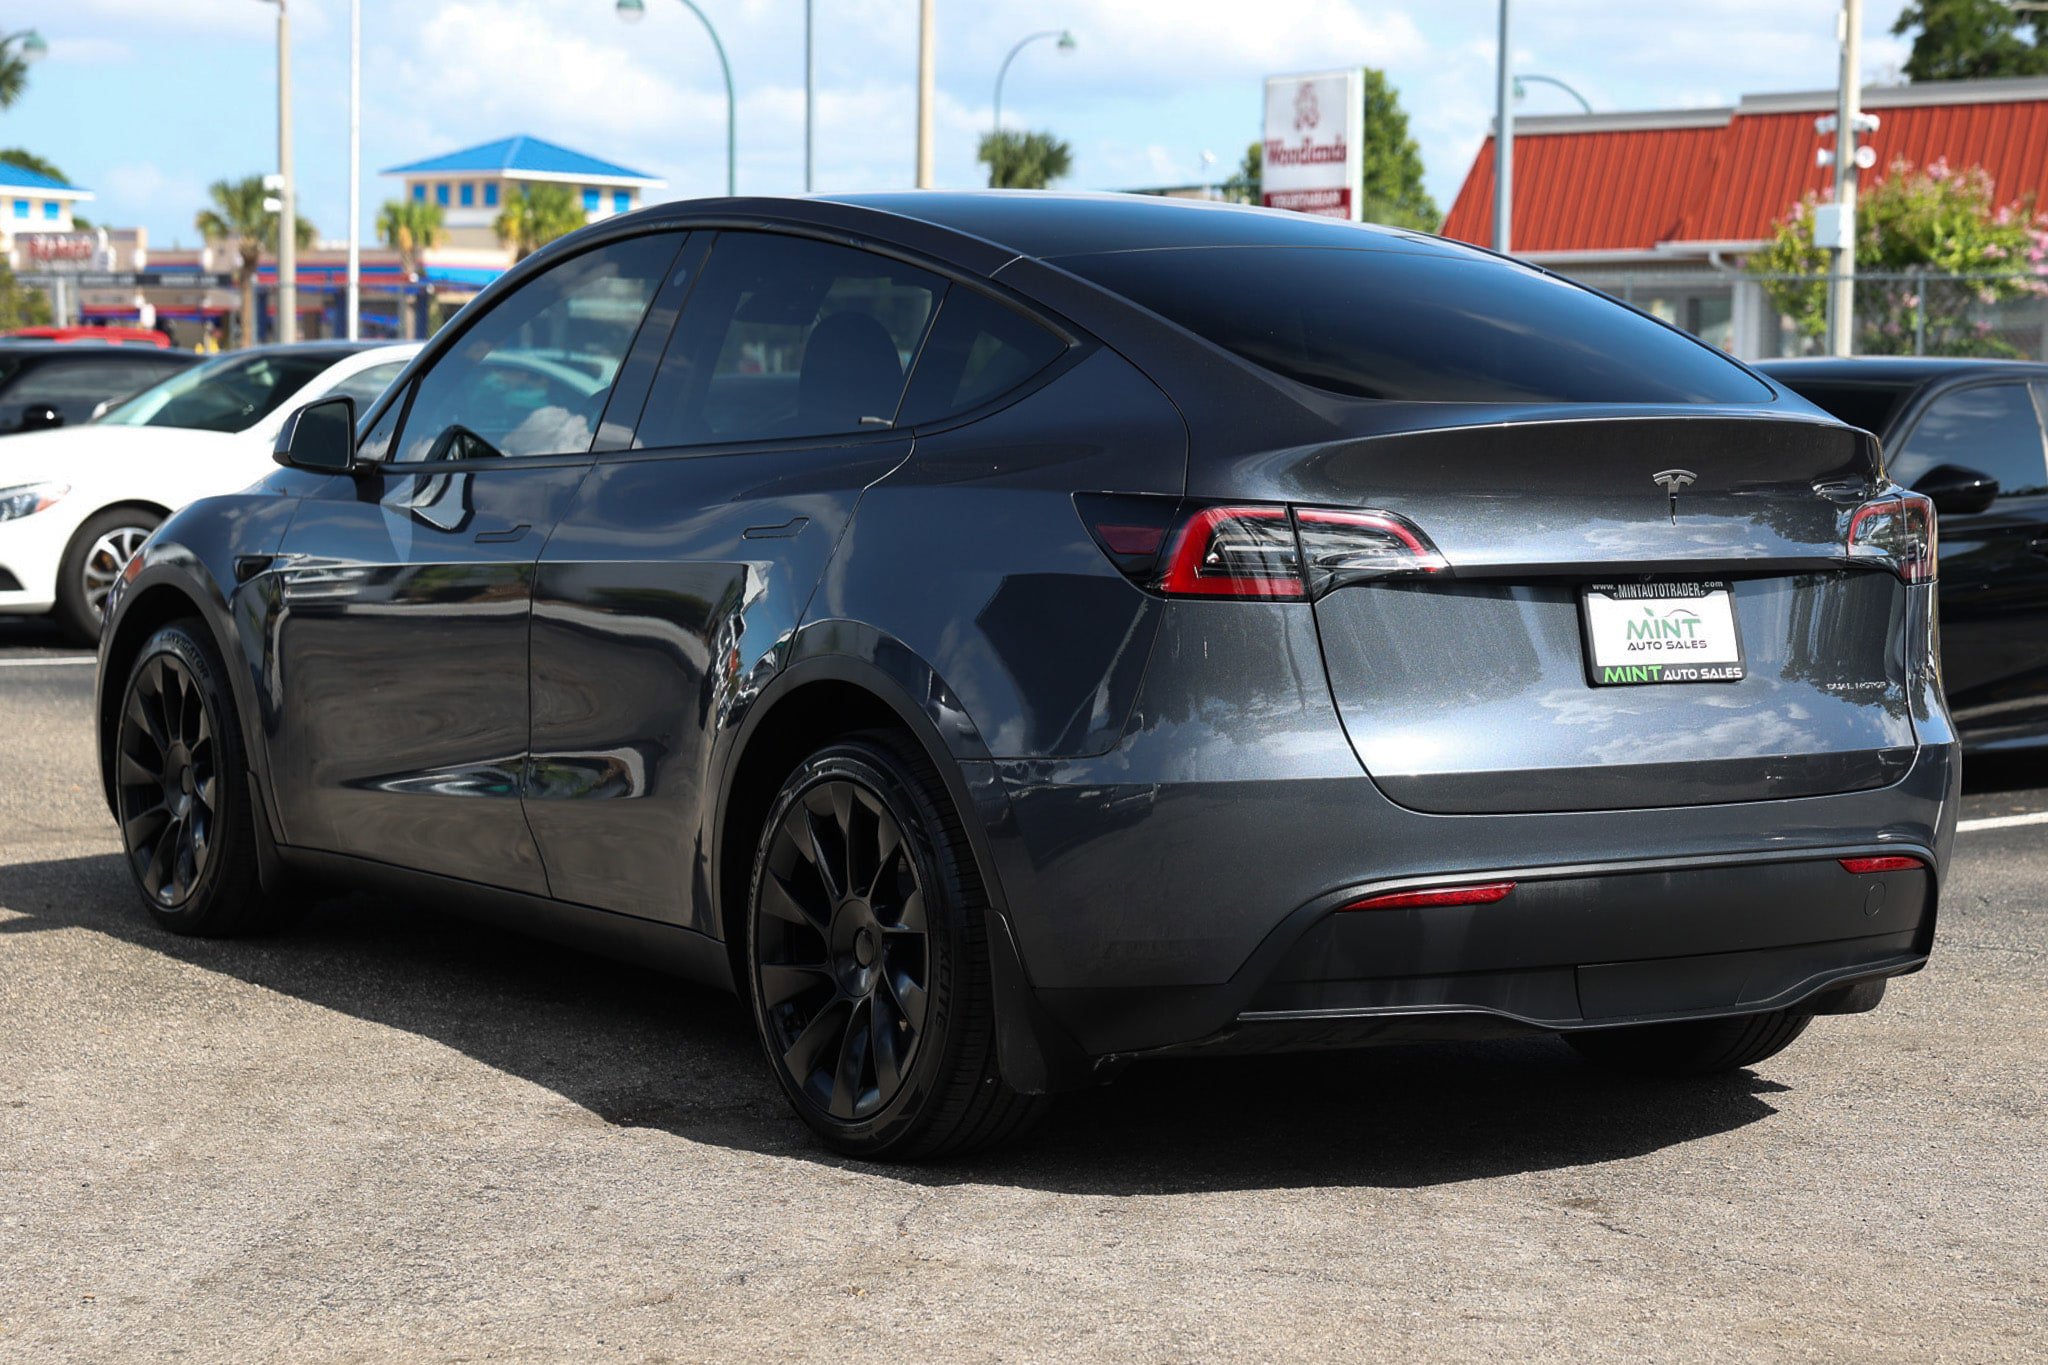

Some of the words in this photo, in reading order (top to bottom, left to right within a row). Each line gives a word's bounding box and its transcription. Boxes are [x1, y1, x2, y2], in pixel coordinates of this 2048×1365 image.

[1627, 618, 1702, 640] MINT
[1627, 641, 1663, 651] AUTO
[1665, 640, 1708, 650] SALES
[1604, 665, 1662, 683] MINT
[1663, 668, 1698, 681] AUTO
[1700, 667, 1743, 680] SALES
